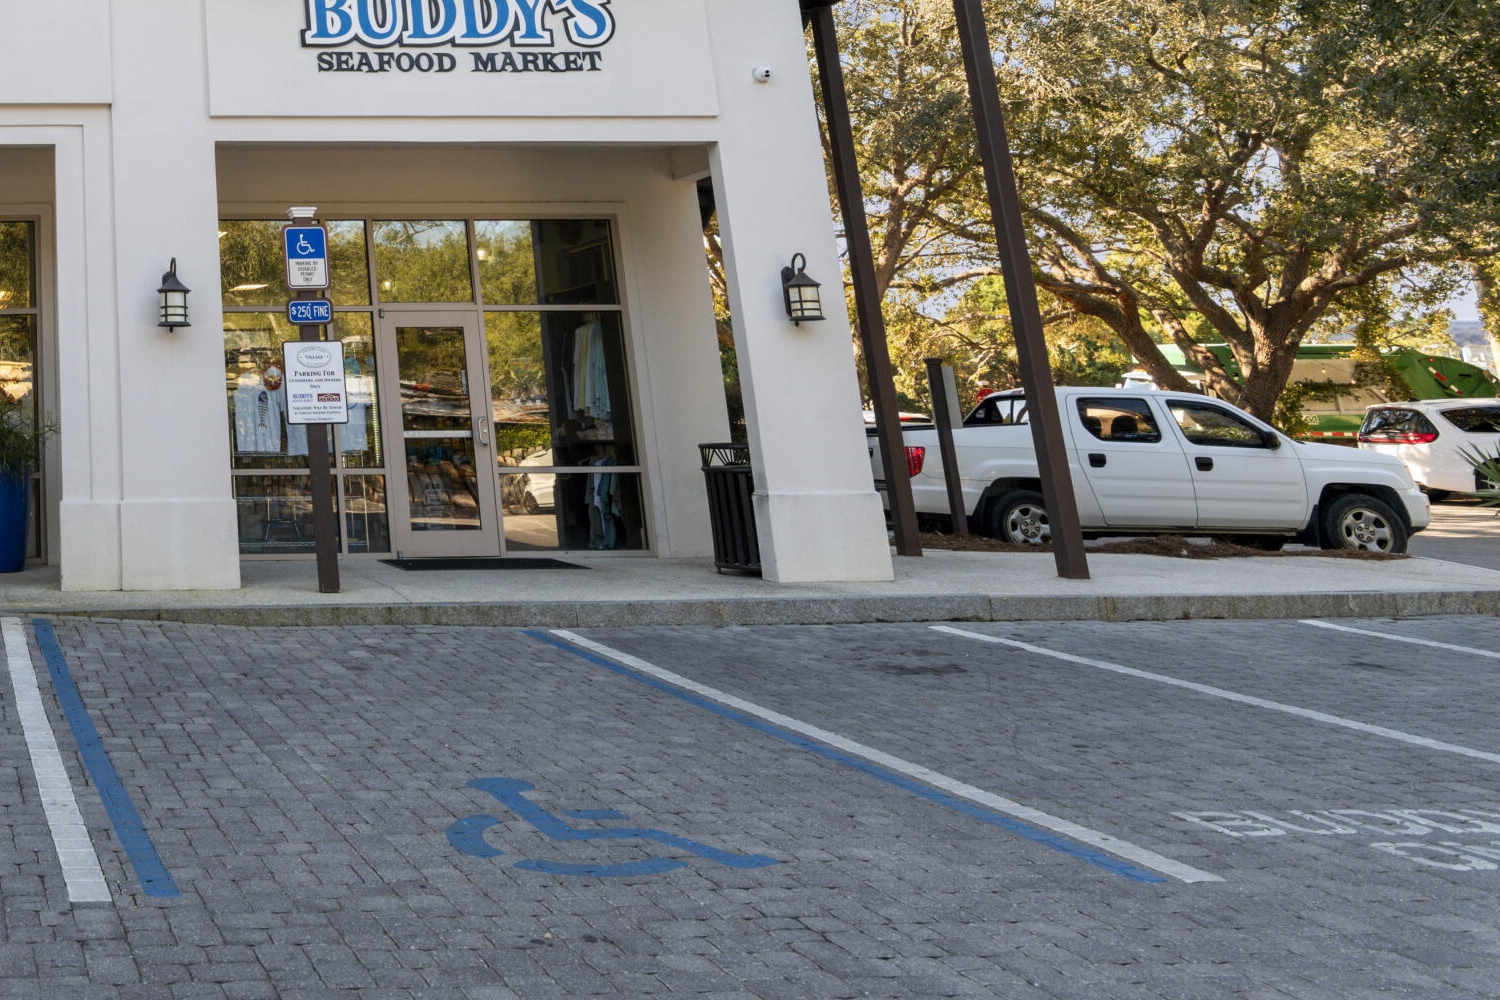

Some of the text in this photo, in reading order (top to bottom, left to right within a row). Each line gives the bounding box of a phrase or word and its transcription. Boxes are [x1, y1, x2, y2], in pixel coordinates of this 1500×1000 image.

[317, 51, 603, 73] SEAFOOD MARKET
[313, 304, 329, 318] FINE
